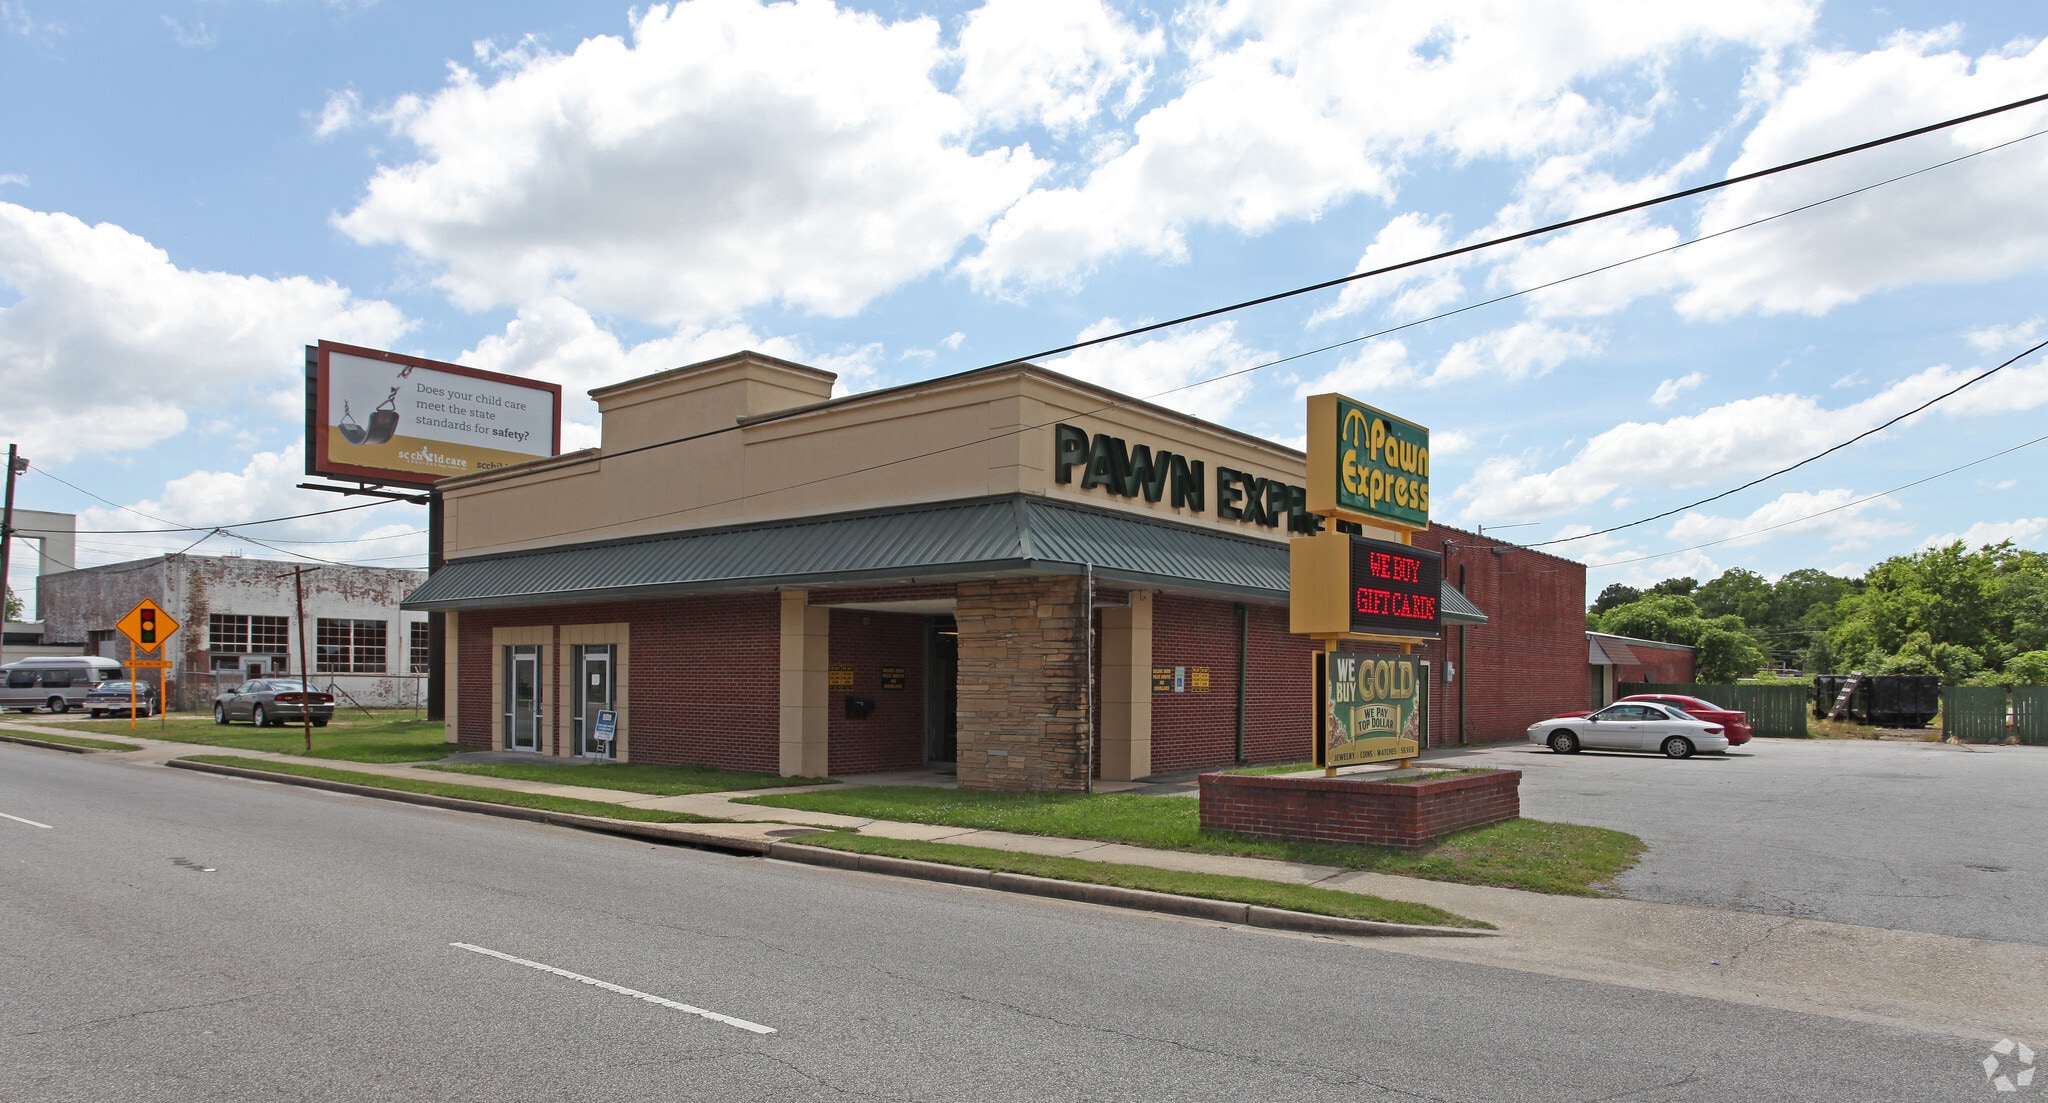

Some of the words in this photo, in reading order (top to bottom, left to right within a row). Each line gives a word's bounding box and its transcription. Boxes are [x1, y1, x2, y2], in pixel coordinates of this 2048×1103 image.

[416, 383, 445, 396] Does
[447, 390, 473, 401] your
[475, 394, 502, 406] child
[504, 400, 527, 411] care
[416, 400, 446, 412] meet
[448, 404, 467, 416] the
[469, 409, 496, 421] state
[416, 416, 472, 432] standards
[474, 423, 490, 435] for
[492, 428, 530, 442] safety?
[1369, 418, 1429, 478] Pawn
[445, 457, 468, 467] care
[1055, 423, 1204, 513] PAWN
[1217, 466, 1362, 537] EXPR
[1342, 449, 1428, 512] Express
[1370, 551, 1391, 579] WE
[1392, 556, 1421, 583] BUY
[1357, 587, 1390, 615] GIFT
[1391, 592, 1437, 620] CARDS
[1337, 658, 1356, 682] WE
[1358, 659, 1415, 702] GOLD
[1336, 682, 1357, 703] BUY
[1358, 720, 1371, 732] TOP
[1371, 718, 1394, 730] DOLLAR
[1364, 708, 1375, 719] WE
[1376, 707, 1389, 718] PAY
[1334, 752, 1355, 762] JEWELRY
[1360, 750, 1373, 759] COINS
[1377, 747, 1397, 757] WATCHES
[1400, 746, 1414, 754] SILVER
